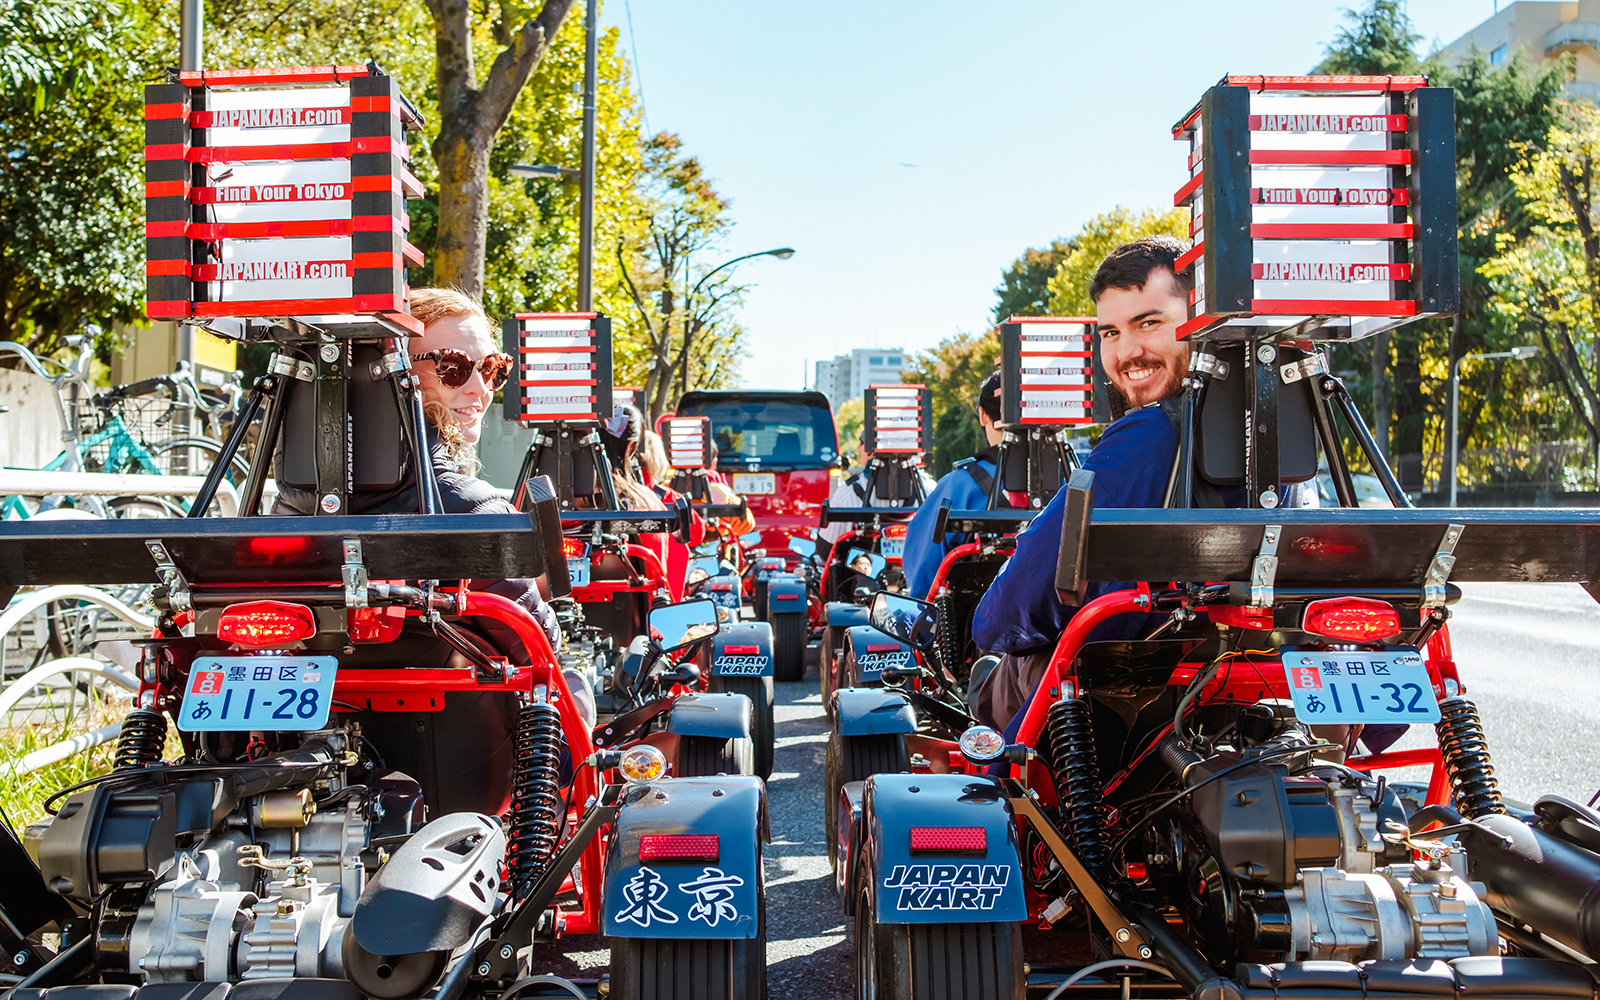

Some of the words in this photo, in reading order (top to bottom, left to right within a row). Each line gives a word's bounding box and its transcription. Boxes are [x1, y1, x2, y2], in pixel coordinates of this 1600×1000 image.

[211, 108, 342, 127] JAPANKART.com
[1260, 114, 1387, 131] JAPANKART.com
[215, 186, 250, 201] Find
[255, 185, 292, 200] Your
[295, 183, 345, 200] Tokyo
[1262, 188, 1296, 203] Find
[1299, 188, 1336, 203] Your
[1340, 188, 1388, 205] Tokyo
[215, 261, 346, 280] JAPANKART.com
[1262, 262, 1389, 280] JAPANKART.com
[715, 656, 768, 666] JAPAN
[858, 651, 910, 664] JAPAN
[228, 666, 298, 681] 墨田区
[720, 665, 764, 675] KART
[1322, 661, 1391, 675] 墨田区
[191, 700, 212, 720] あ
[220, 688, 319, 720] 11-28
[1306, 694, 1326, 714] あ
[1329, 683, 1429, 713] 11-32
[884, 865, 1011, 887] JAPAN
[615, 866, 744, 927] 東京
[897, 886, 1003, 910] KART
